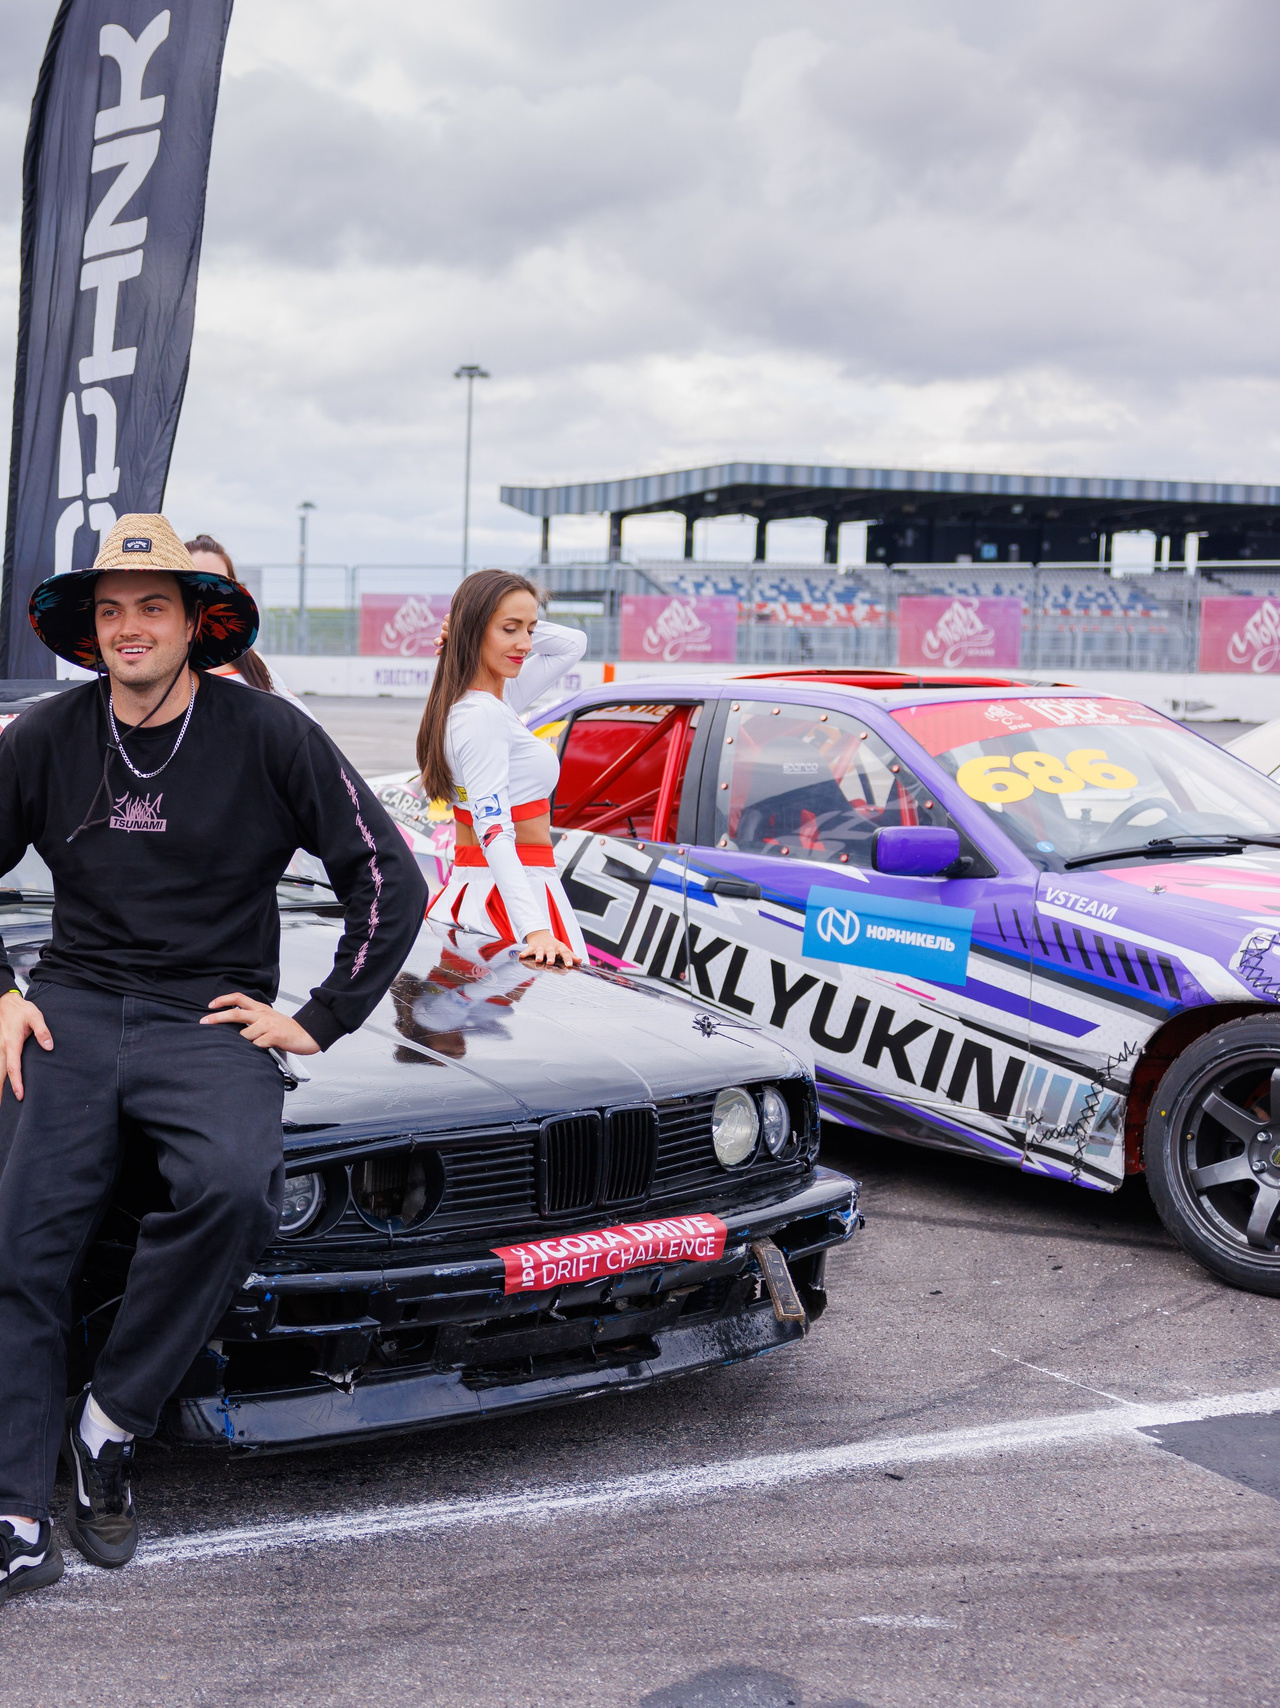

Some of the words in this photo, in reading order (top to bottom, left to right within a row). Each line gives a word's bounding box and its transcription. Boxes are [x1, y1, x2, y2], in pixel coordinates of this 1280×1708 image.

[782, 761, 819, 774] sparco
[956, 749, 1139, 803] 686
[113, 818, 164, 830] TSUNAMI
[1045, 887, 1118, 921] VSTEAM
[865, 923, 956, 953] НОРНИКЕЛЬ
[528, 1230, 631, 1262] IGORA
[622, 1216, 715, 1243] DRIVE
[510, 1247, 535, 1287] IDDC
[542, 1253, 603, 1285] DRIFT
[606, 1236, 715, 1271] CHALLENGE
